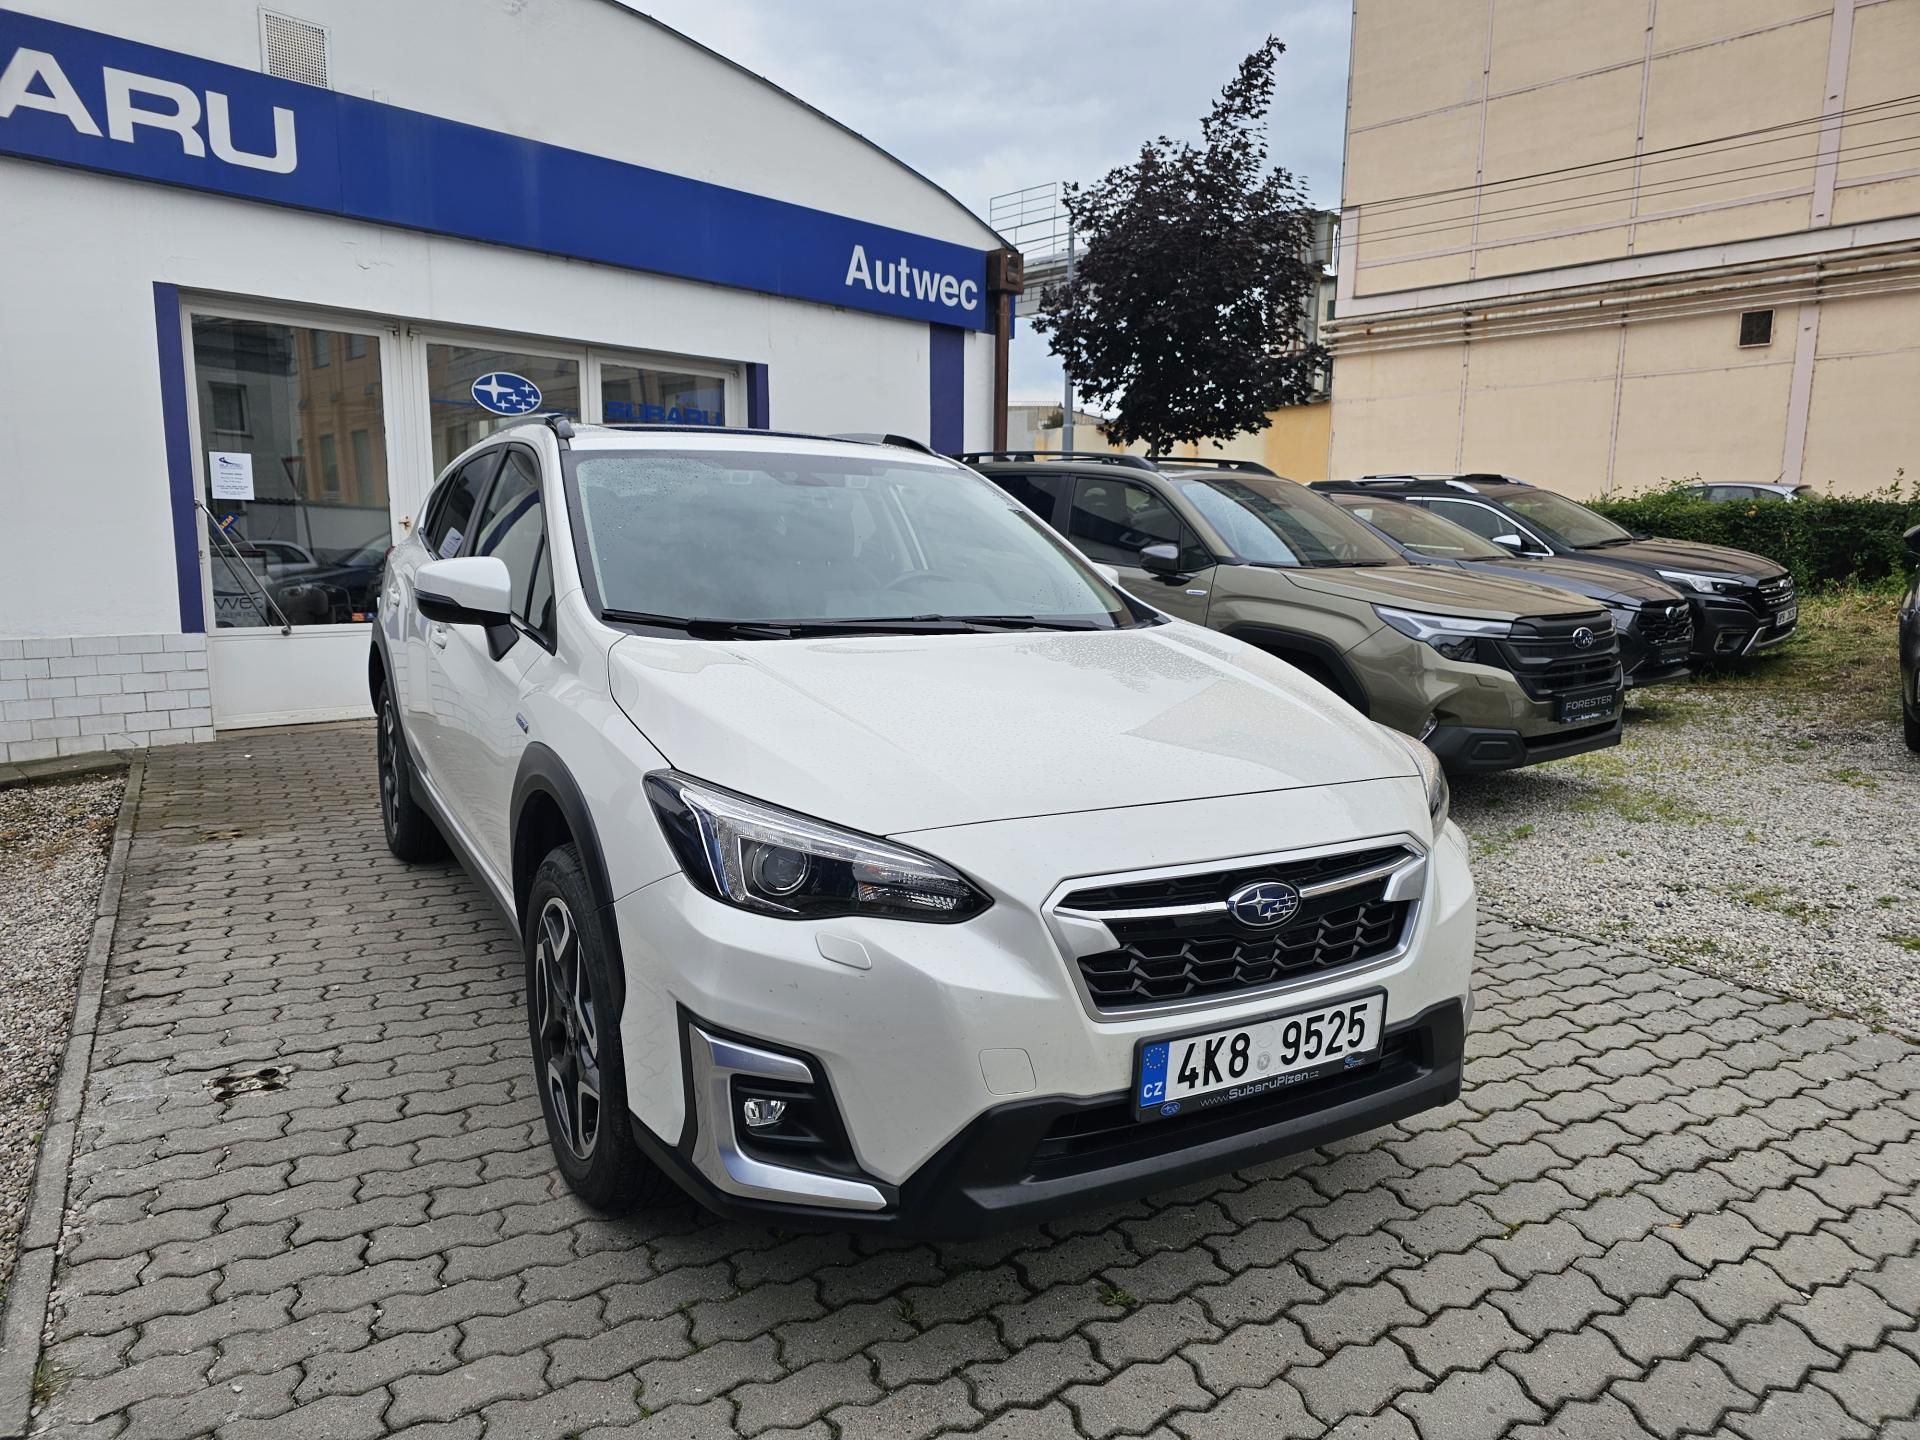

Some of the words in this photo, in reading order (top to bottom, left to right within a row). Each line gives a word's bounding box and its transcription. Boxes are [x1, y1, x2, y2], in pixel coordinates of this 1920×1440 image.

[0, 46, 298, 174] ARU
[845, 244, 978, 311] Autwec
[1565, 694, 1613, 711] FORESTER
[1177, 1032, 1251, 1089] 4K8
[1280, 1003, 1368, 1066] 9525
[1143, 1081, 1163, 1099] CZ
[1200, 1069, 1320, 1108] www.SubaruPlzen.cz
